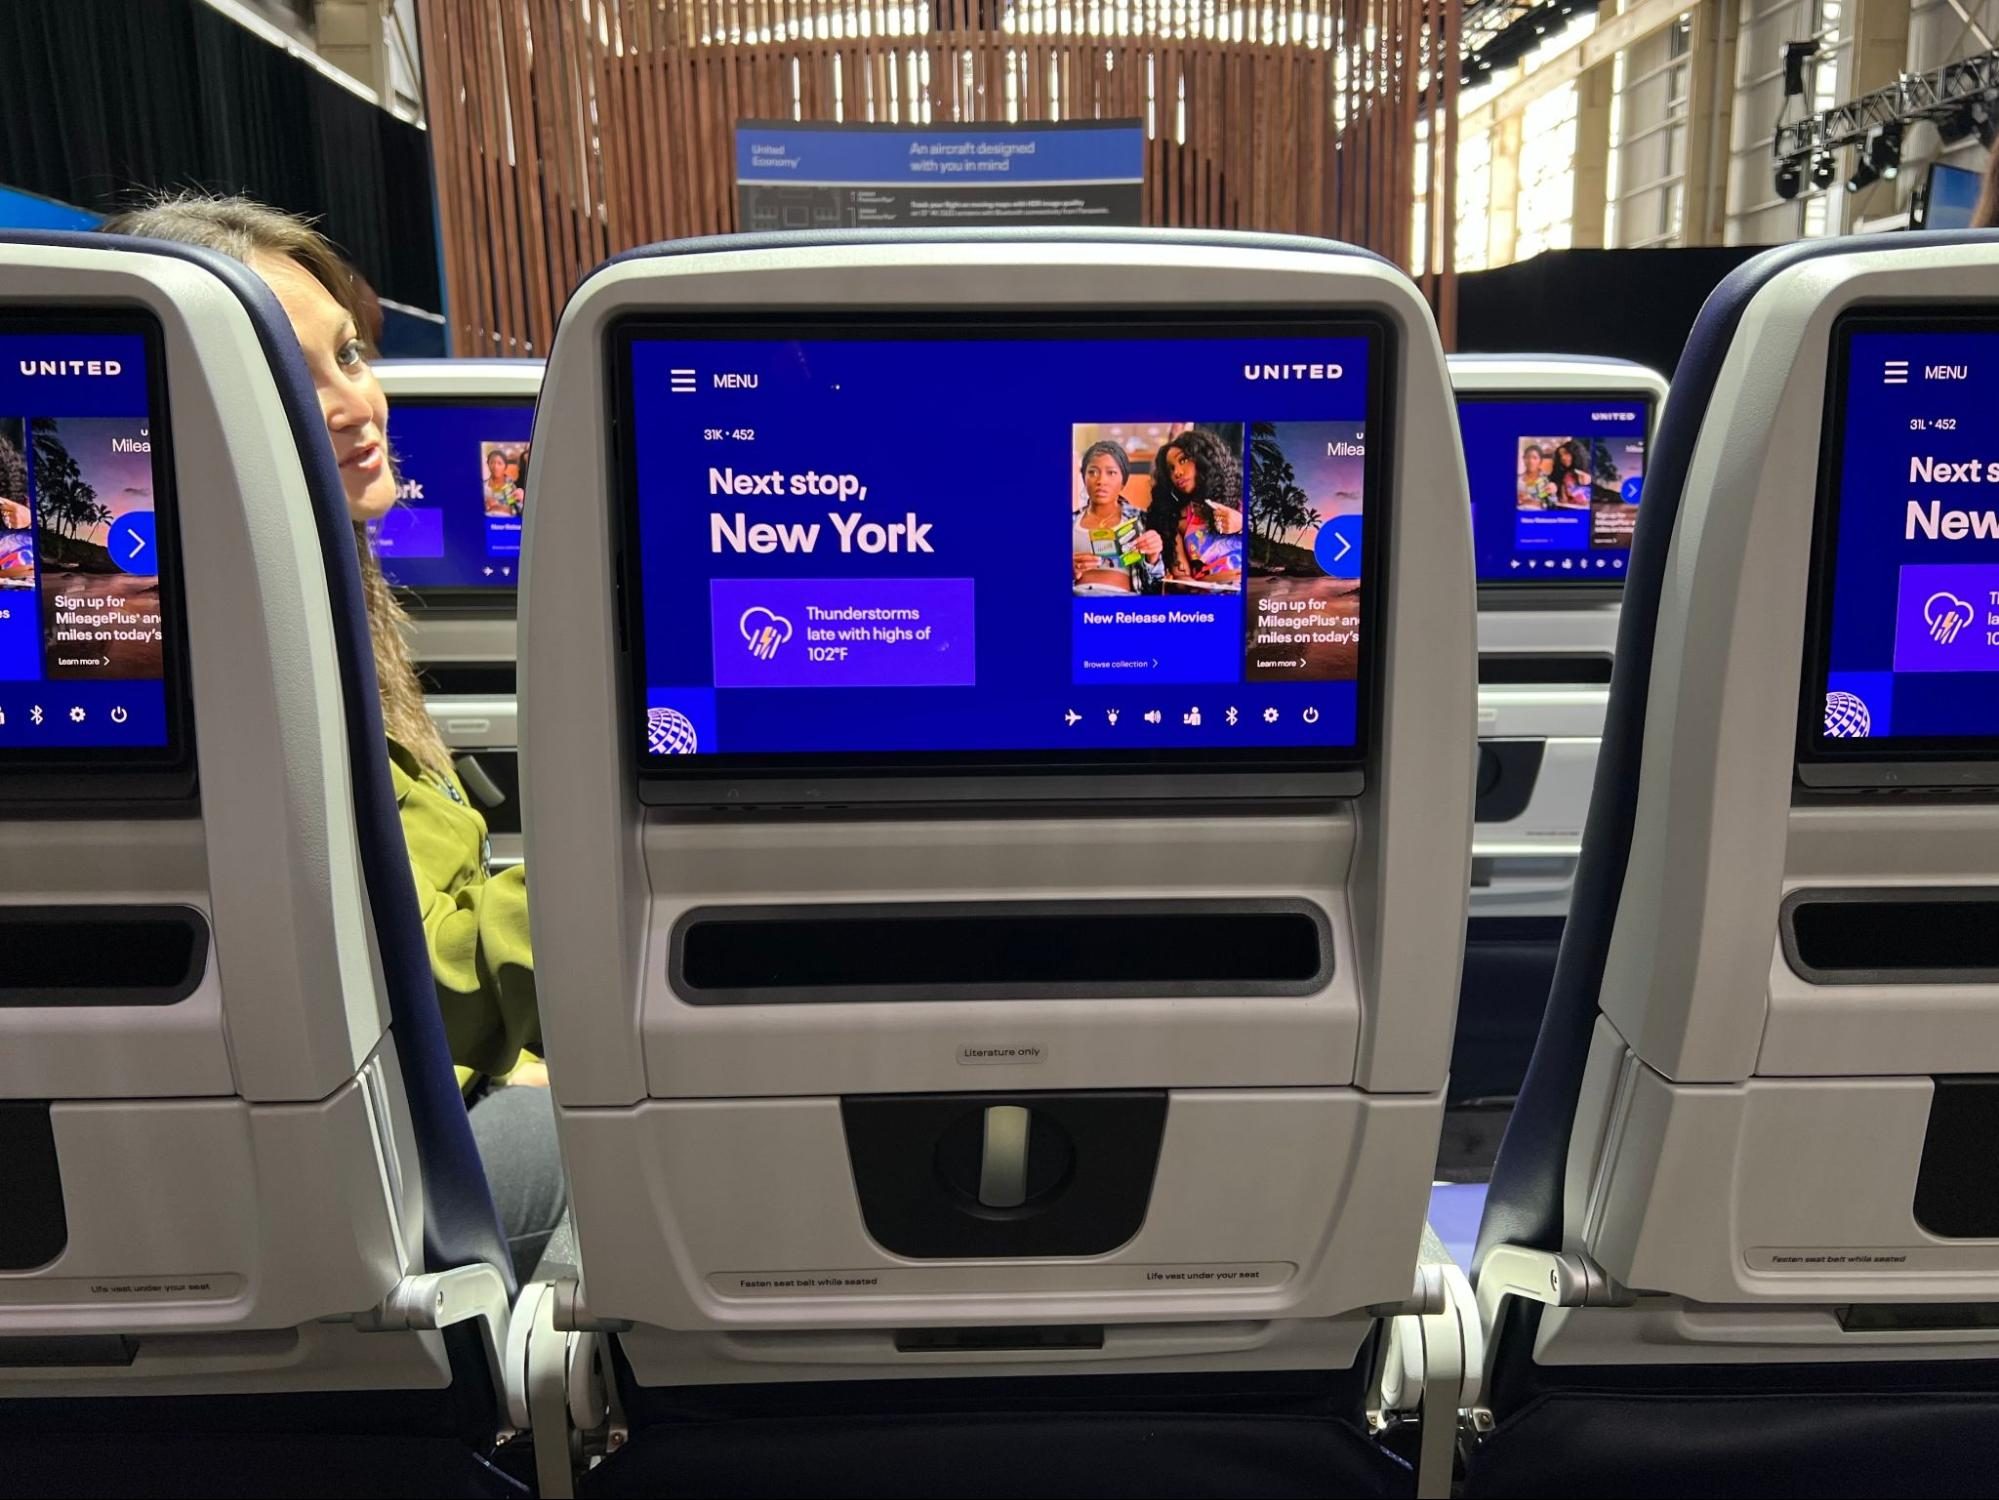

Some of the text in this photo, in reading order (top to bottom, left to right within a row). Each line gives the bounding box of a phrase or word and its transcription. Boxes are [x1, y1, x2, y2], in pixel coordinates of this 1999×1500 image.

[751, 144, 785, 155] United
[910, 141, 1035, 157] An aircraft designed
[910, 159, 1010, 174] with you in mind
[20, 360, 122, 376] UNITED
[1244, 364, 1343, 380] UNITED
[1925, 365, 1968, 380] MENU
[713, 374, 758, 389] MENU
[1591, 412, 1635, 421] UNITED
[1910, 419, 1956, 430] 31L 452
[704, 429, 755, 441] 31K 452
[1909, 456, 1982, 483] Next
[709, 467, 867, 502] Next stop,
[1905, 500, 1999, 540] New
[710, 512, 934, 553] New York
[55, 595, 125, 610] Sign up for
[1258, 598, 1327, 613] Sign up for
[806, 606, 920, 621] Thunderstorms
[1083, 611, 1215, 624] New Release Movies
[57, 628, 162, 643] miles on today's
[807, 626, 931, 644] late with highs of
[1258, 631, 1359, 645] miles on today's
[58, 657, 79, 665] Learn
[807, 647, 849, 662] 102°F
[1083, 660, 1148, 669] Browse collection
[1257, 660, 1277, 668] Learn
[964, 1047, 1041, 1057] Literature only
[1827, 1255, 1846, 1263] belt
[1848, 1255, 1872, 1263] while
[1873, 1255, 1906, 1263] seated
[740, 1277, 878, 1288] Fasten seat belt while seated
[1147, 1272, 1163, 1280] Life
[1165, 1272, 1185, 1280] vest
[1187, 1272, 1214, 1280] under
[1216, 1271, 1238, 1280] your
[91, 1283, 211, 1293] Life vest under your seat
